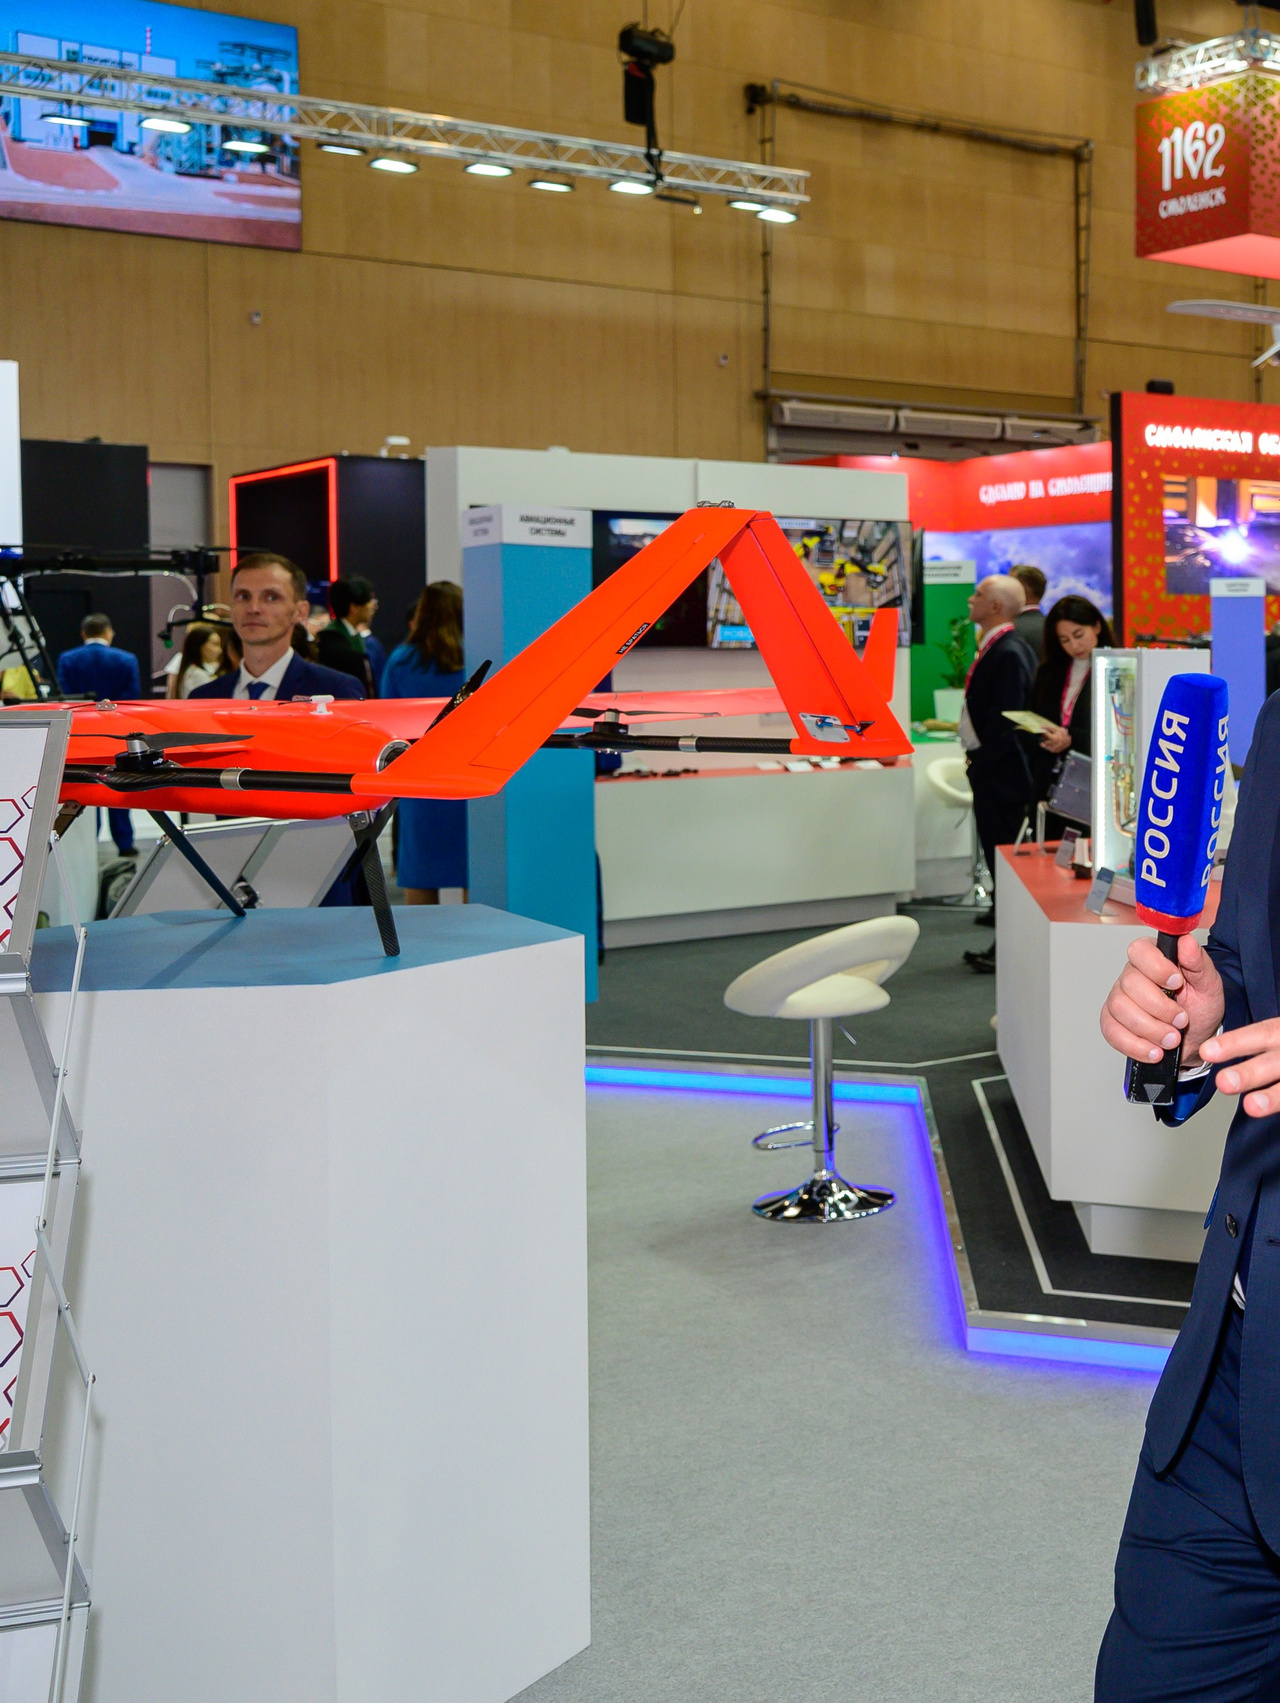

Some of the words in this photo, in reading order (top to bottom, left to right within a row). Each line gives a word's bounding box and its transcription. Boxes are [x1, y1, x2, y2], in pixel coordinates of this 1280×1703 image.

[1158, 120, 1226, 192] 1162
[1158, 186, 1227, 219] СМОЛЕНСК
[1145, 424, 1253, 454] СМОЛЕНСКАЯ
[1029, 479, 1045, 498] НА
[1140, 709, 1190, 888] РОССИЯ
